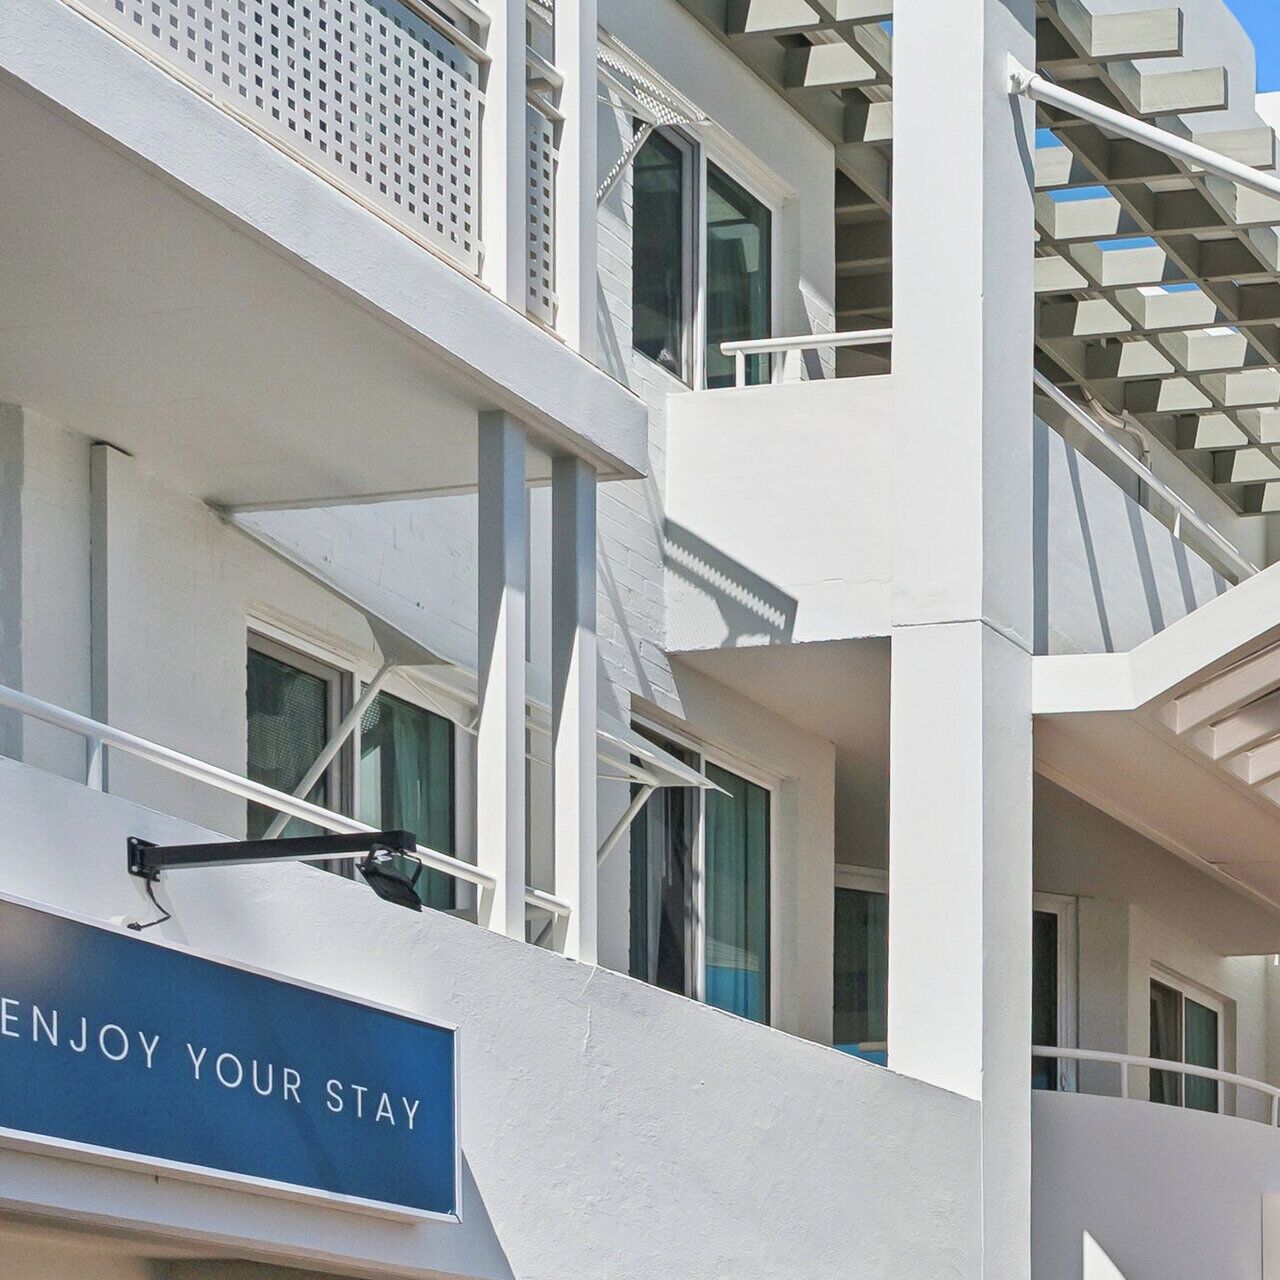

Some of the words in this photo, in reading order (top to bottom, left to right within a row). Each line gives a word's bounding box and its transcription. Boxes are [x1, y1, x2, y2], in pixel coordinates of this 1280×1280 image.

[1, 997, 160, 1068] ENJOY
[186, 1043, 301, 1104] YOUR
[326, 1079, 420, 1130] STAY
